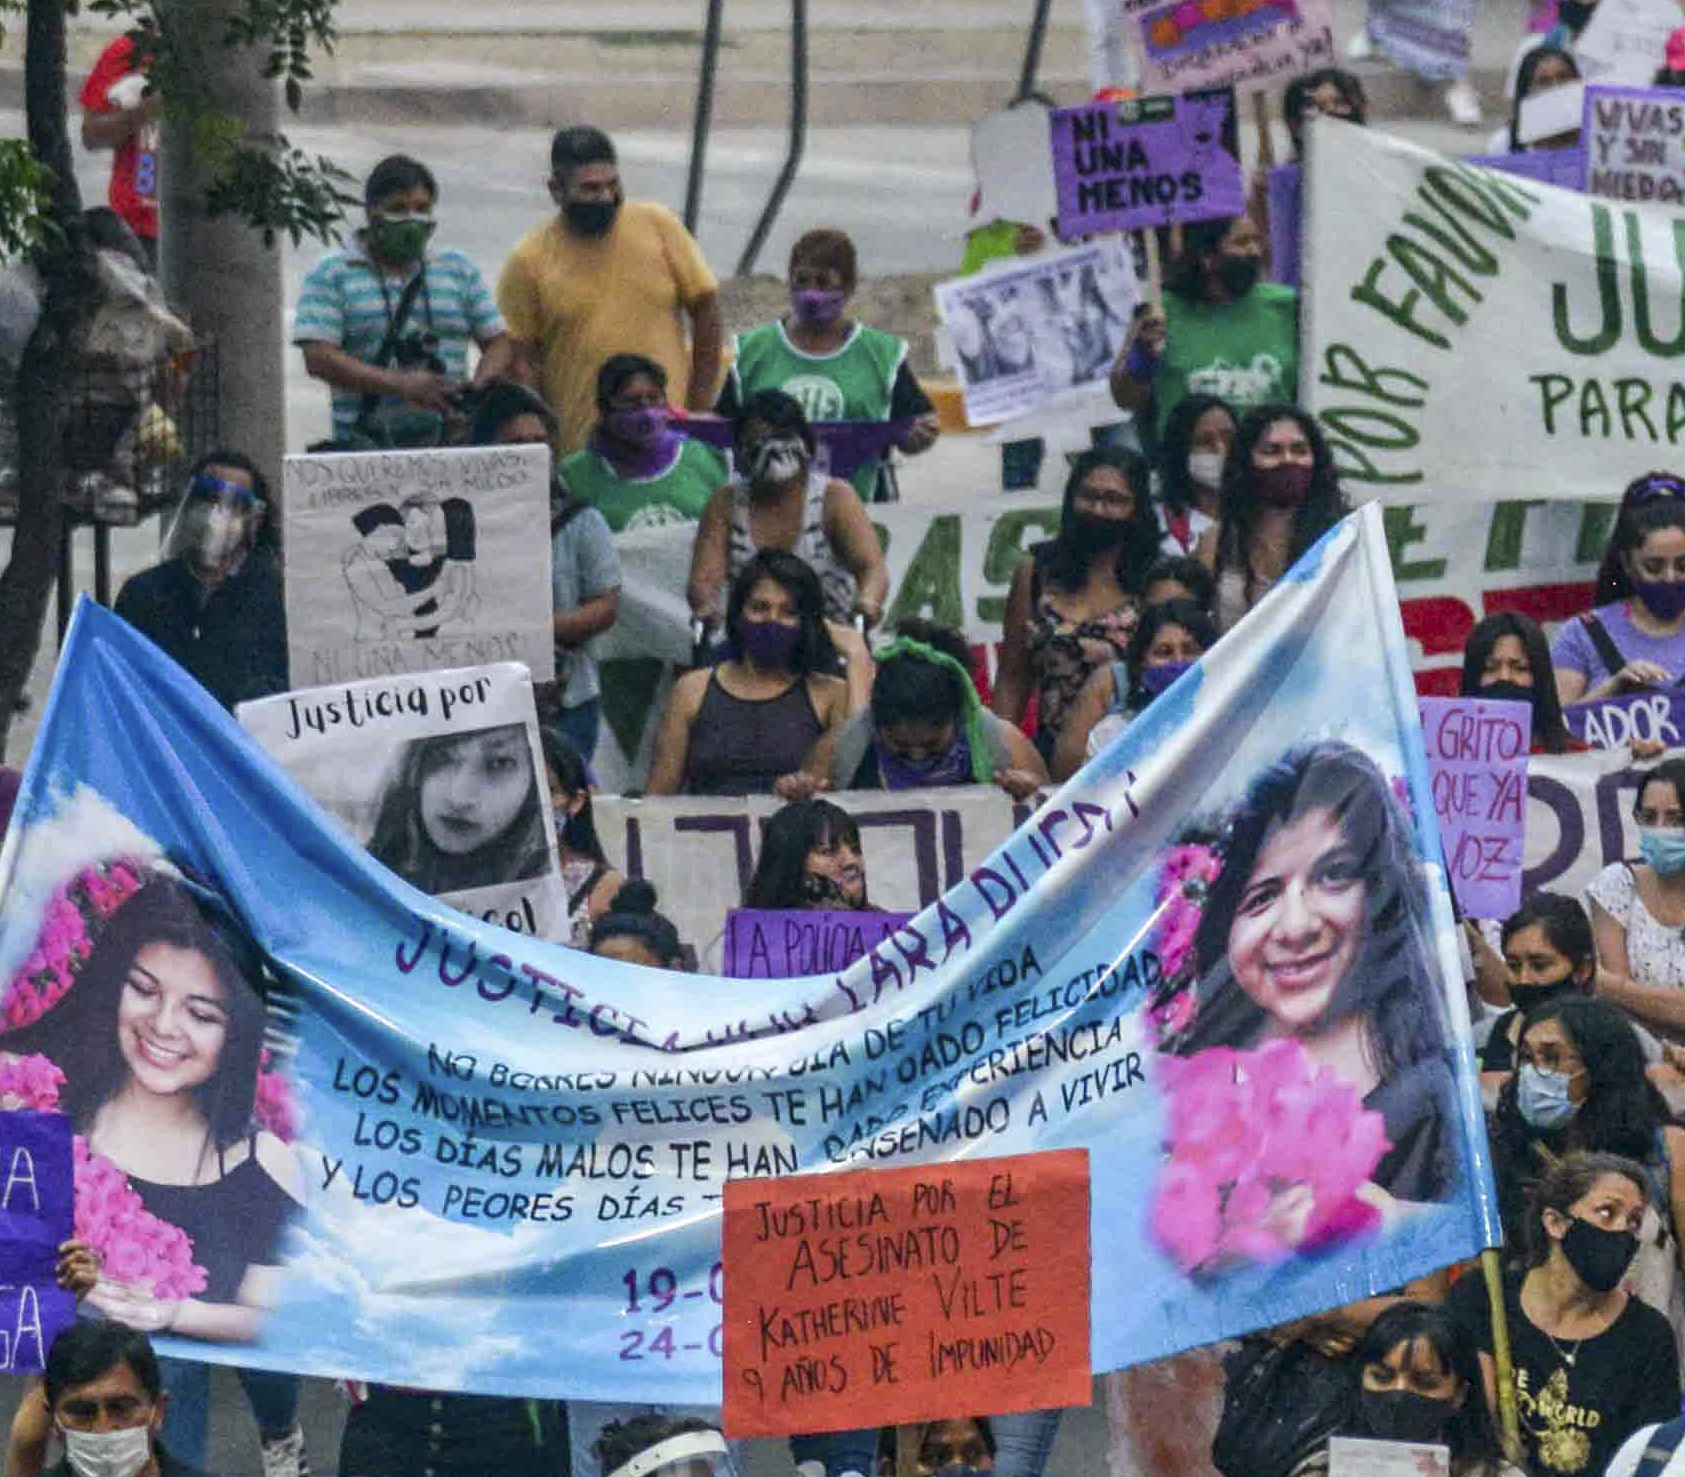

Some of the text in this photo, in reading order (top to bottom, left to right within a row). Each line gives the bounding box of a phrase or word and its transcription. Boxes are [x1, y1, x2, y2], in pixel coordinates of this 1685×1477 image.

[1071, 110, 1109, 143] NI
[1595, 100, 1684, 135] VIVAS
[1597, 135, 1614, 164] Y
[1074, 139, 1149, 175] UNA
[1078, 173, 1205, 215] MENOS
[1319, 343, 1428, 484] POR
[286, 675, 492, 741] Justicia por
[1432, 769, 1522, 825] QUE YA
[331, 951, 1164, 1131] LOS MOMENTOS FELICES TE HAN DADO FELICIDAD
[863, 1021, 912, 1062] DE
[352, 1050, 1147, 1223] LOS PEORES DÍAS A VIVIR
[353, 1111, 422, 1155] LOS
[434, 1131, 523, 1178] DÍAS
[536, 1143, 655, 1180] MALOS
[669, 1140, 712, 1181] TE
[726, 1141, 799, 1180] HAN
[755, 1172, 1021, 1242] JUSTICIA POR EL
[787, 1219, 1029, 1291] ASESINATO DE
[757, 1266, 1028, 1361] KATHERINE VILTE
[741, 1327, 1058, 1402] 9 AÑOS DE IMPUNIDAD
